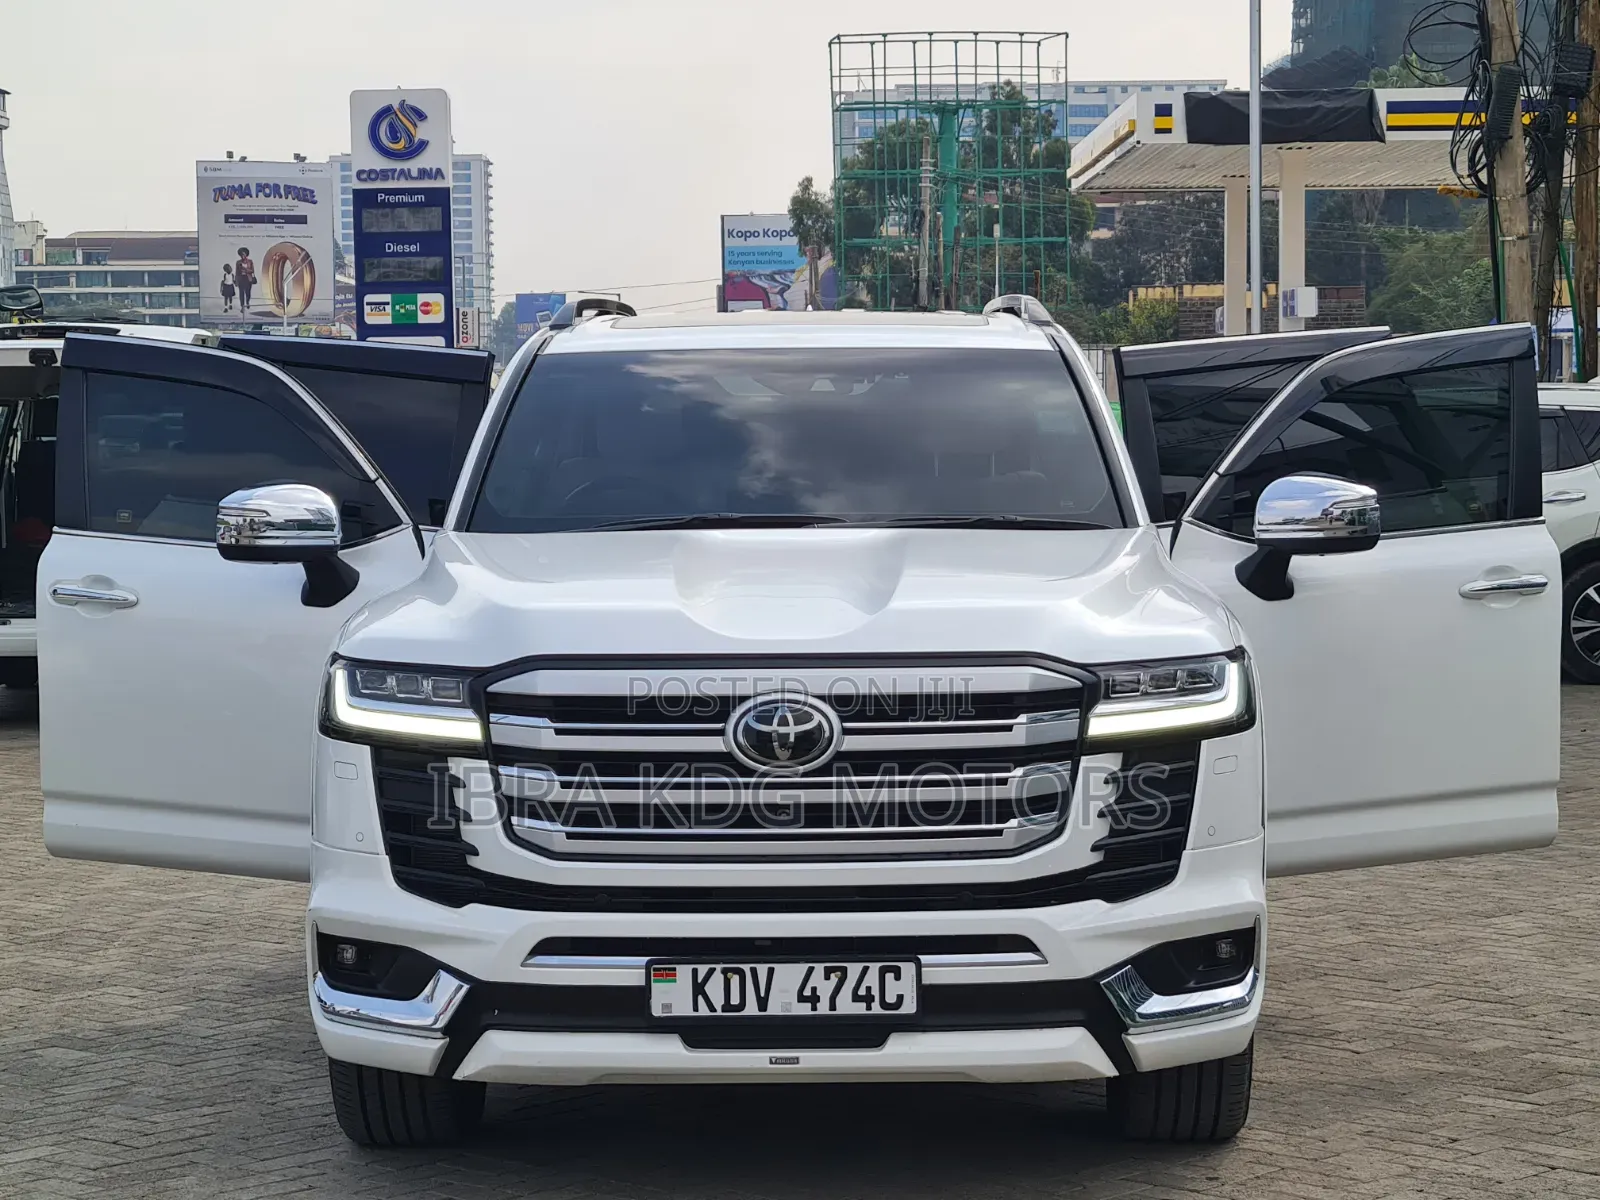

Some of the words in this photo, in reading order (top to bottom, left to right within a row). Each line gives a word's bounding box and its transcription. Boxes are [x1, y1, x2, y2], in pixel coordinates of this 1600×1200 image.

[356, 167, 445, 182] COSTALINA
[212, 183, 252, 203] TUMA
[255, 183, 283, 198] FOR
[283, 184, 318, 204] FREE
[377, 193, 425, 203] Premium
[727, 228, 760, 241] Kopo
[763, 228, 796, 241] Kopo
[385, 242, 420, 253] Diesel
[757, 250, 782, 258] serving
[691, 966, 775, 1013] KDV
[796, 965, 904, 1012] 474C
